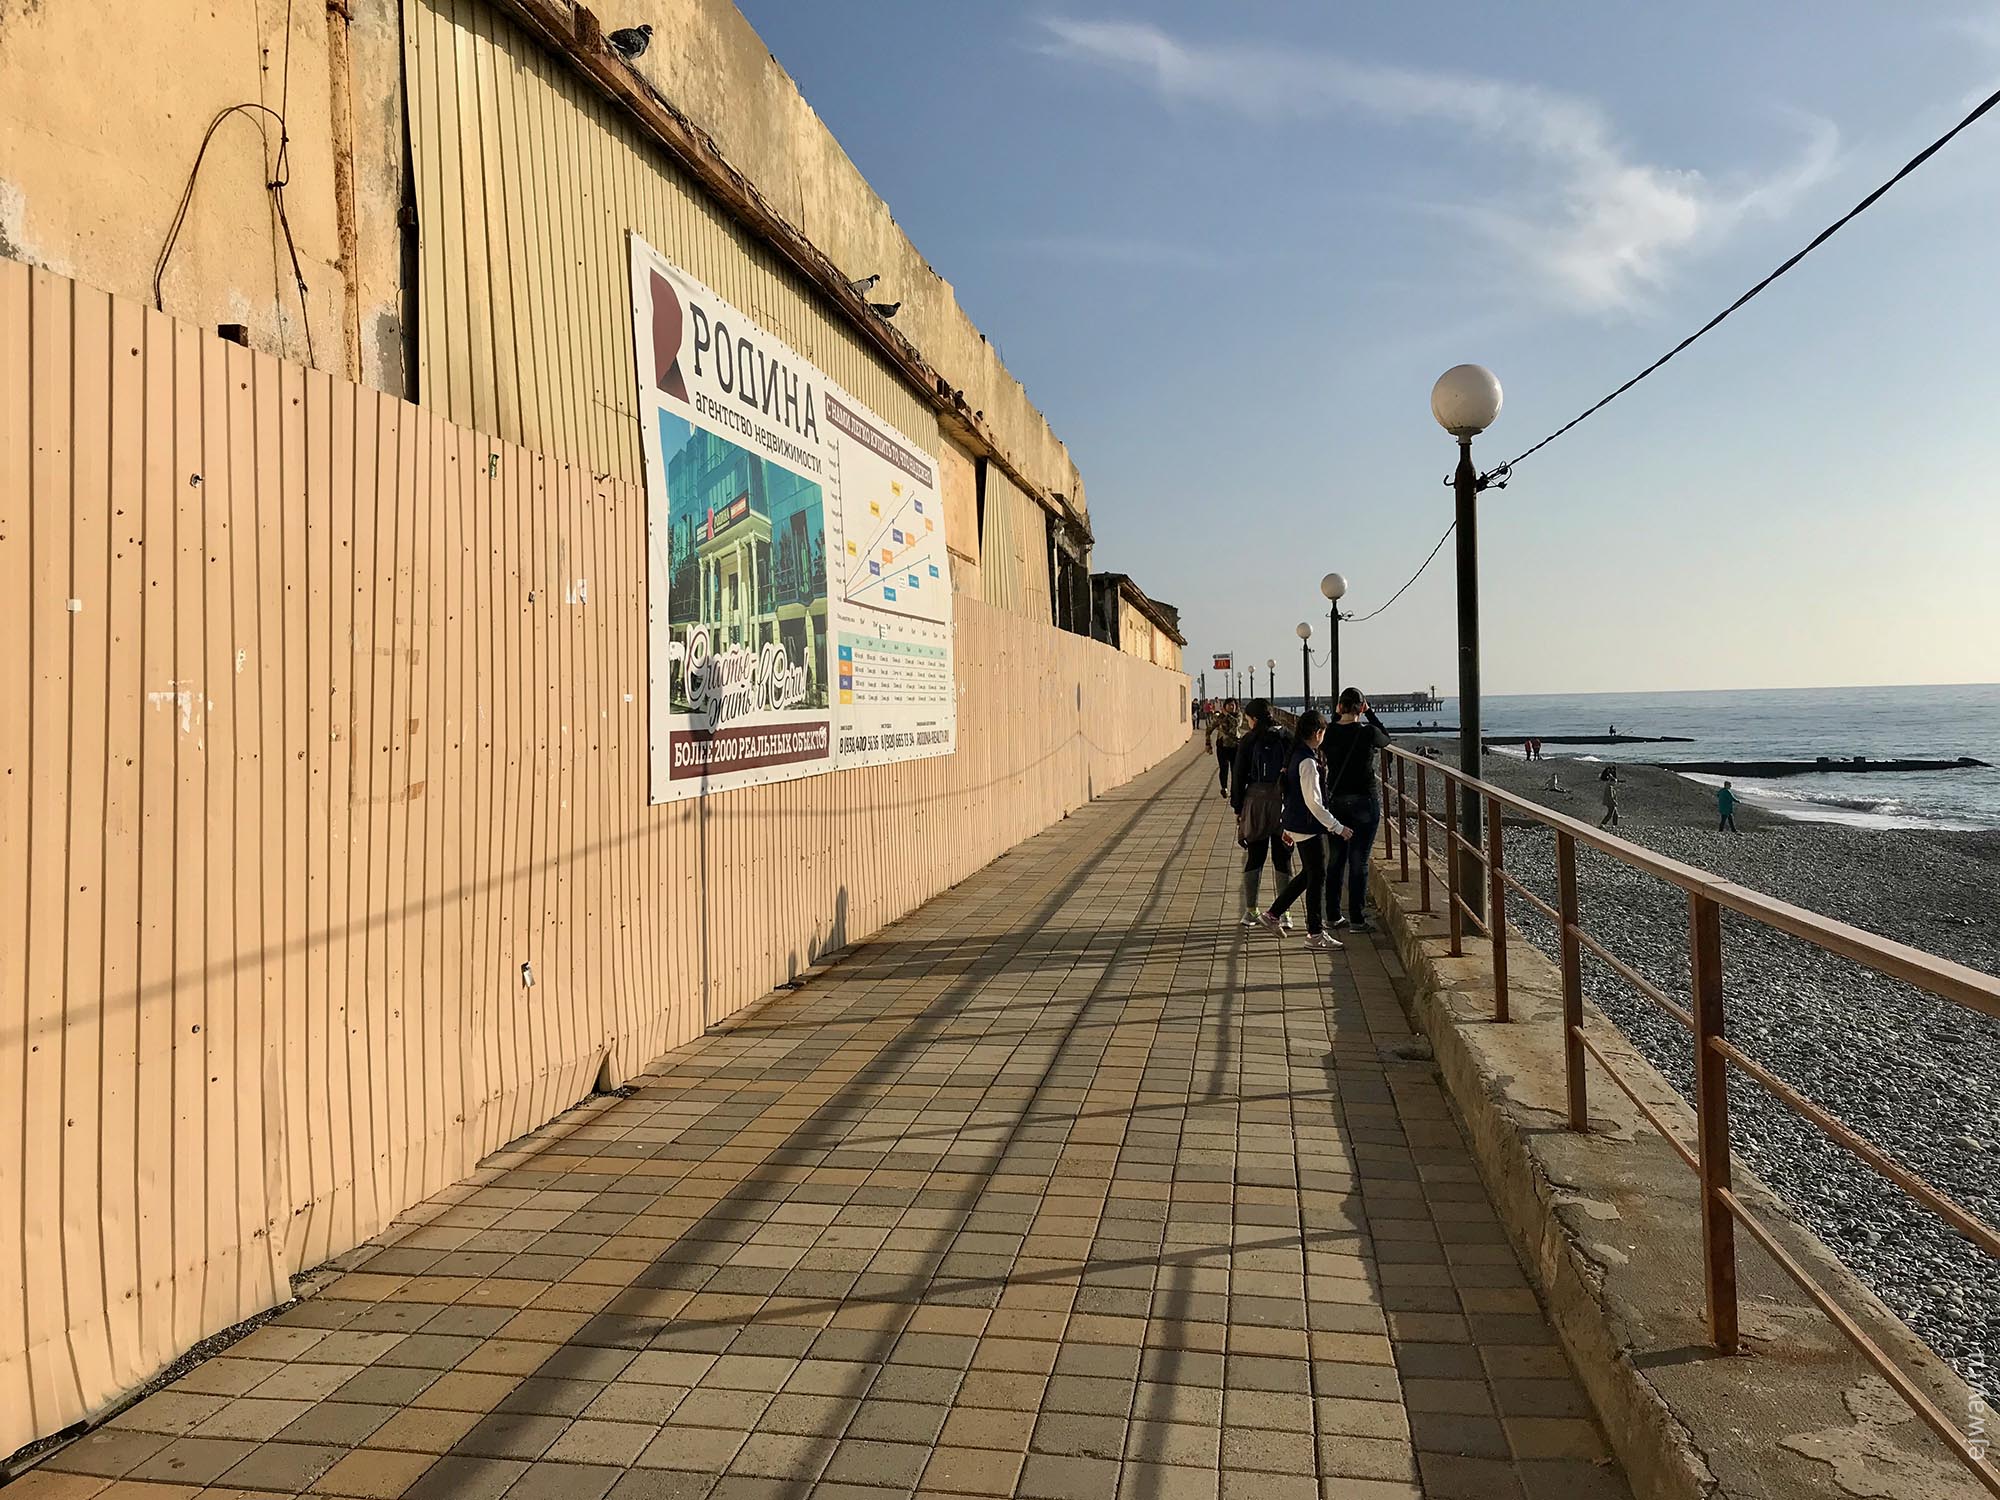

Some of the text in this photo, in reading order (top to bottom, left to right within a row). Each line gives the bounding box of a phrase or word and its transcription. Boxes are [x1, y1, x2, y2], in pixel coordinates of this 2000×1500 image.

[689, 301, 819, 444] РОДИНА
[695, 391, 822, 475] агентство недвижимости
[826, 398, 832, 416] С
[832, 402, 851, 432] НАМИ
[674, 740, 714, 767] БОЛЕЕ
[714, 738, 738, 762] 2000
[738, 732, 792, 760] РЕАЛЬНЫХ
